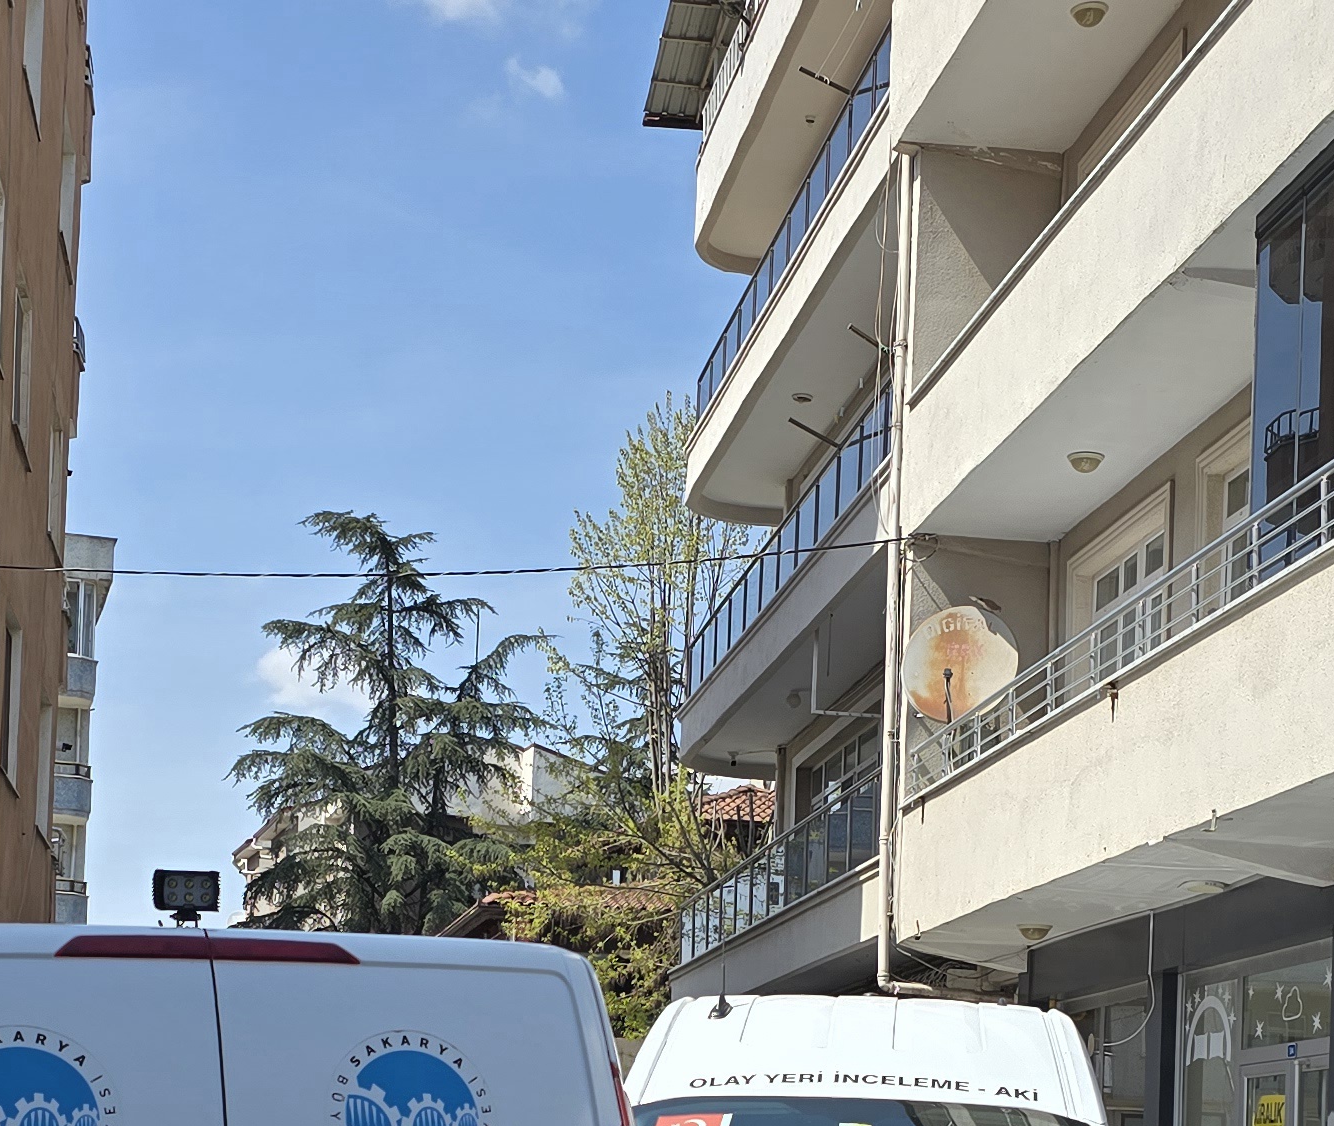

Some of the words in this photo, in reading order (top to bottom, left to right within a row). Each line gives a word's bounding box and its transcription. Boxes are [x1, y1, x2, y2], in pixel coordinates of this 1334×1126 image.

[349, 1034, 463, 1069] SAKARYA
[689, 1073, 757, 1089] OLAY
[764, 1070, 823, 1084] YERİ
[833, 1070, 970, 1092] İNCELEME
[994, 1086, 1039, 1102] AKİ
